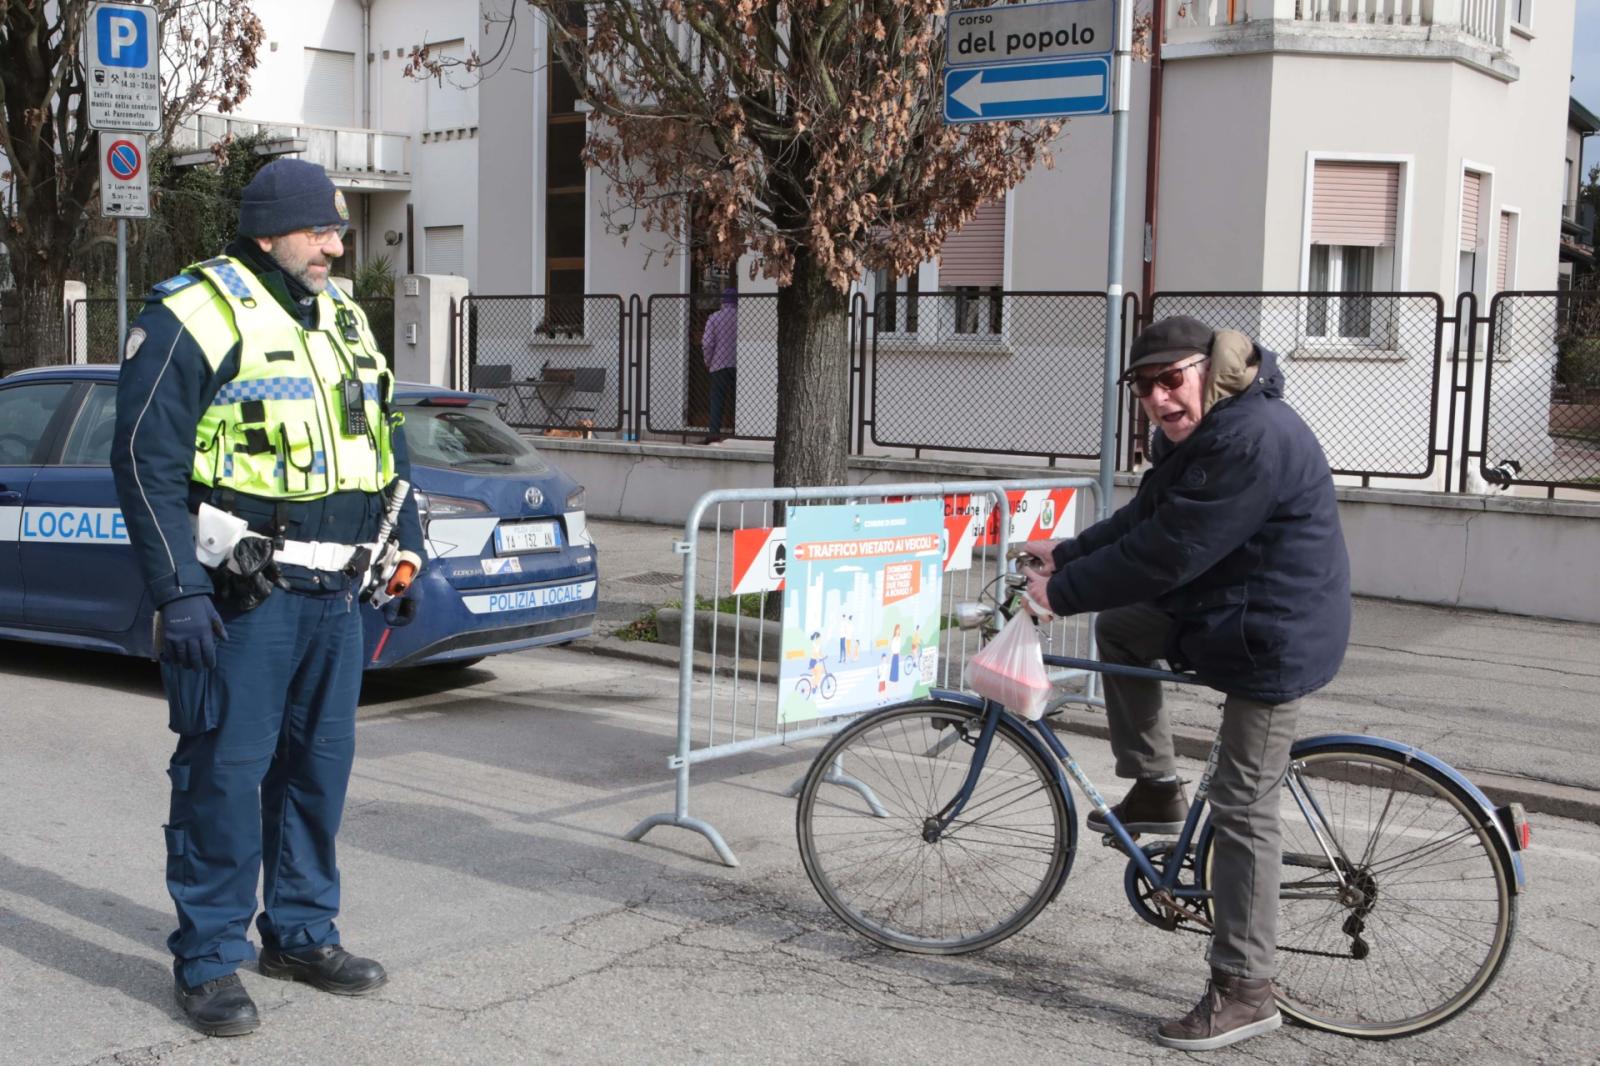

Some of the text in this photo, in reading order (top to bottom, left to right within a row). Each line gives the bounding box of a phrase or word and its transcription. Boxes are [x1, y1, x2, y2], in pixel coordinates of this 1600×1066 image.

[958, 14, 993, 26] corso
[109, 16, 138, 59] P
[958, 23, 1095, 54] del popolo
[24, 511, 127, 539] LOCALE
[808, 536, 931, 558] TRAFFICO VIETATO AI VEICOLI
[489, 584, 582, 612] POLIZIA LOCALE
